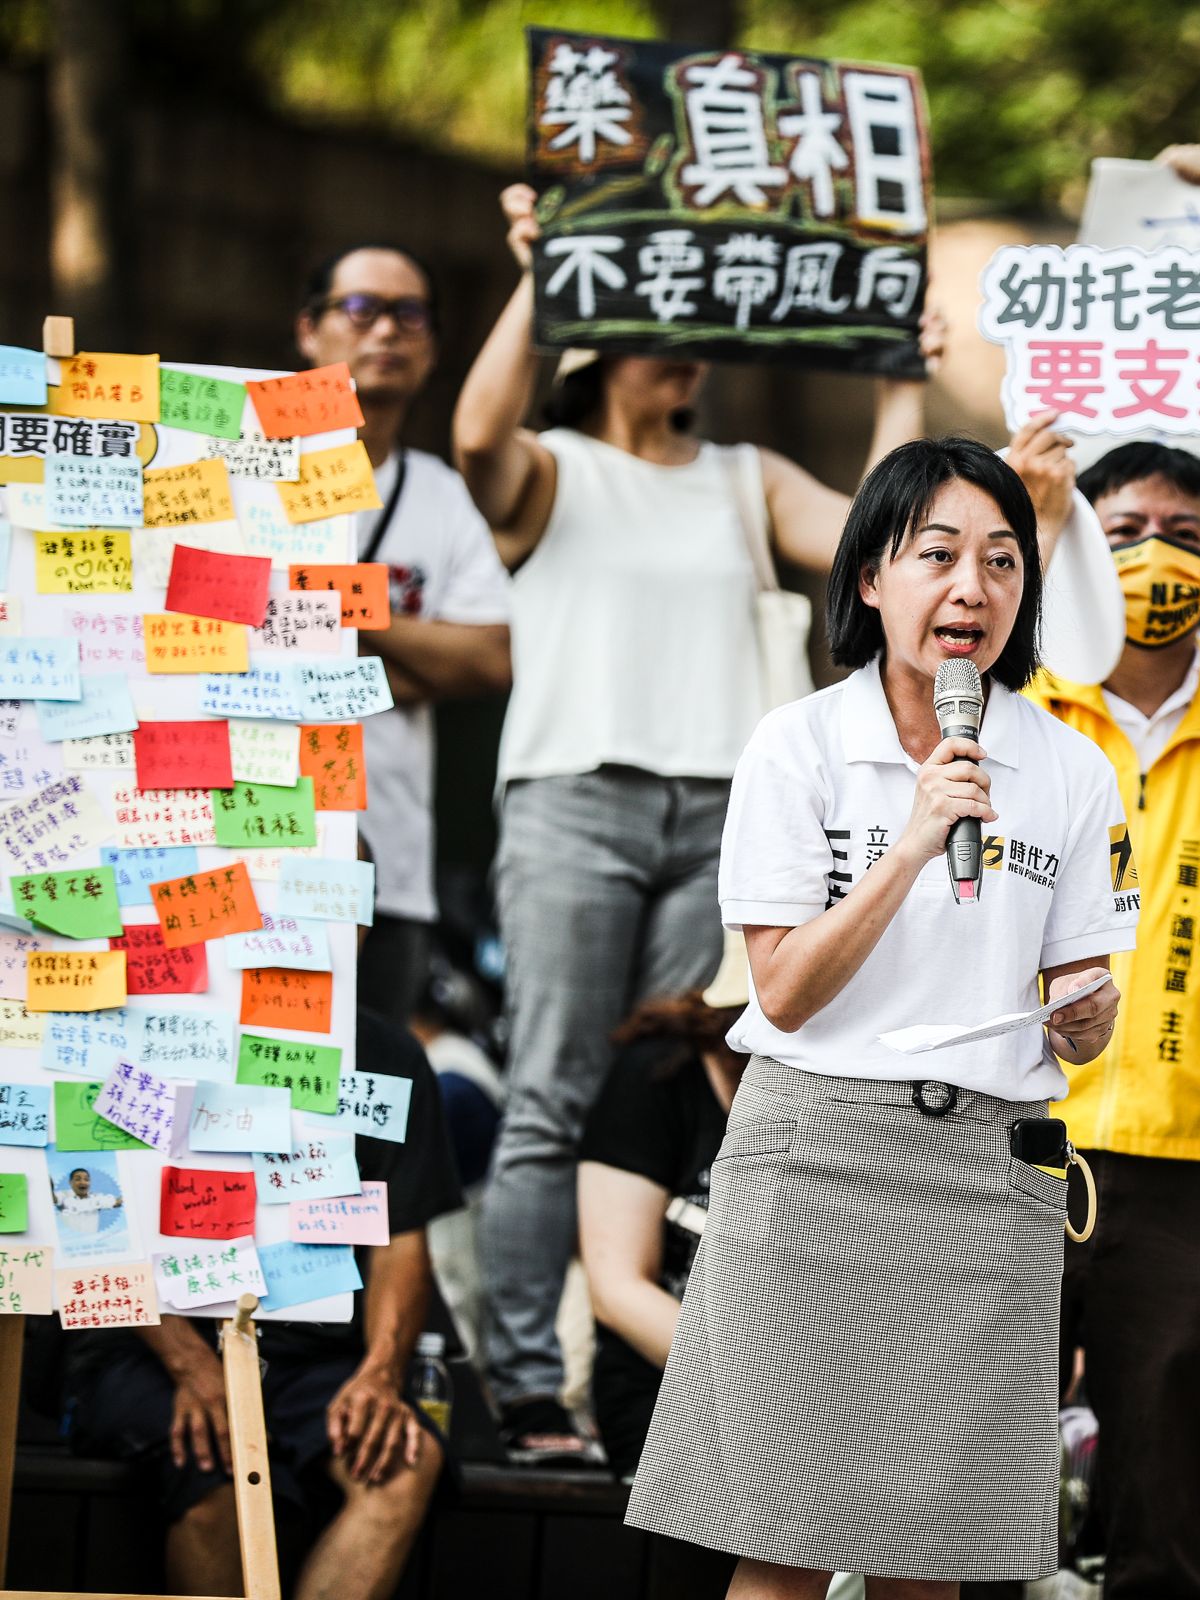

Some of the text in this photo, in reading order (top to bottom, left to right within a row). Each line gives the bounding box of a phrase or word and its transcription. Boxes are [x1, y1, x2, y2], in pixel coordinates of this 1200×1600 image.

[539, 43, 928, 236] 藥 真相
[544, 229, 923, 331] 不要帶風向
[0, 417, 137, 458] 要確實
[1008, 861, 1025, 878] NEW
[1024, 867, 1048, 888] POWER
[1009, 838, 1060, 878] 時代力
[1114, 893, 1140, 913] 時代
[1157, 1008, 1184, 1064] 主任
[193, 1102, 254, 1133] 加油
